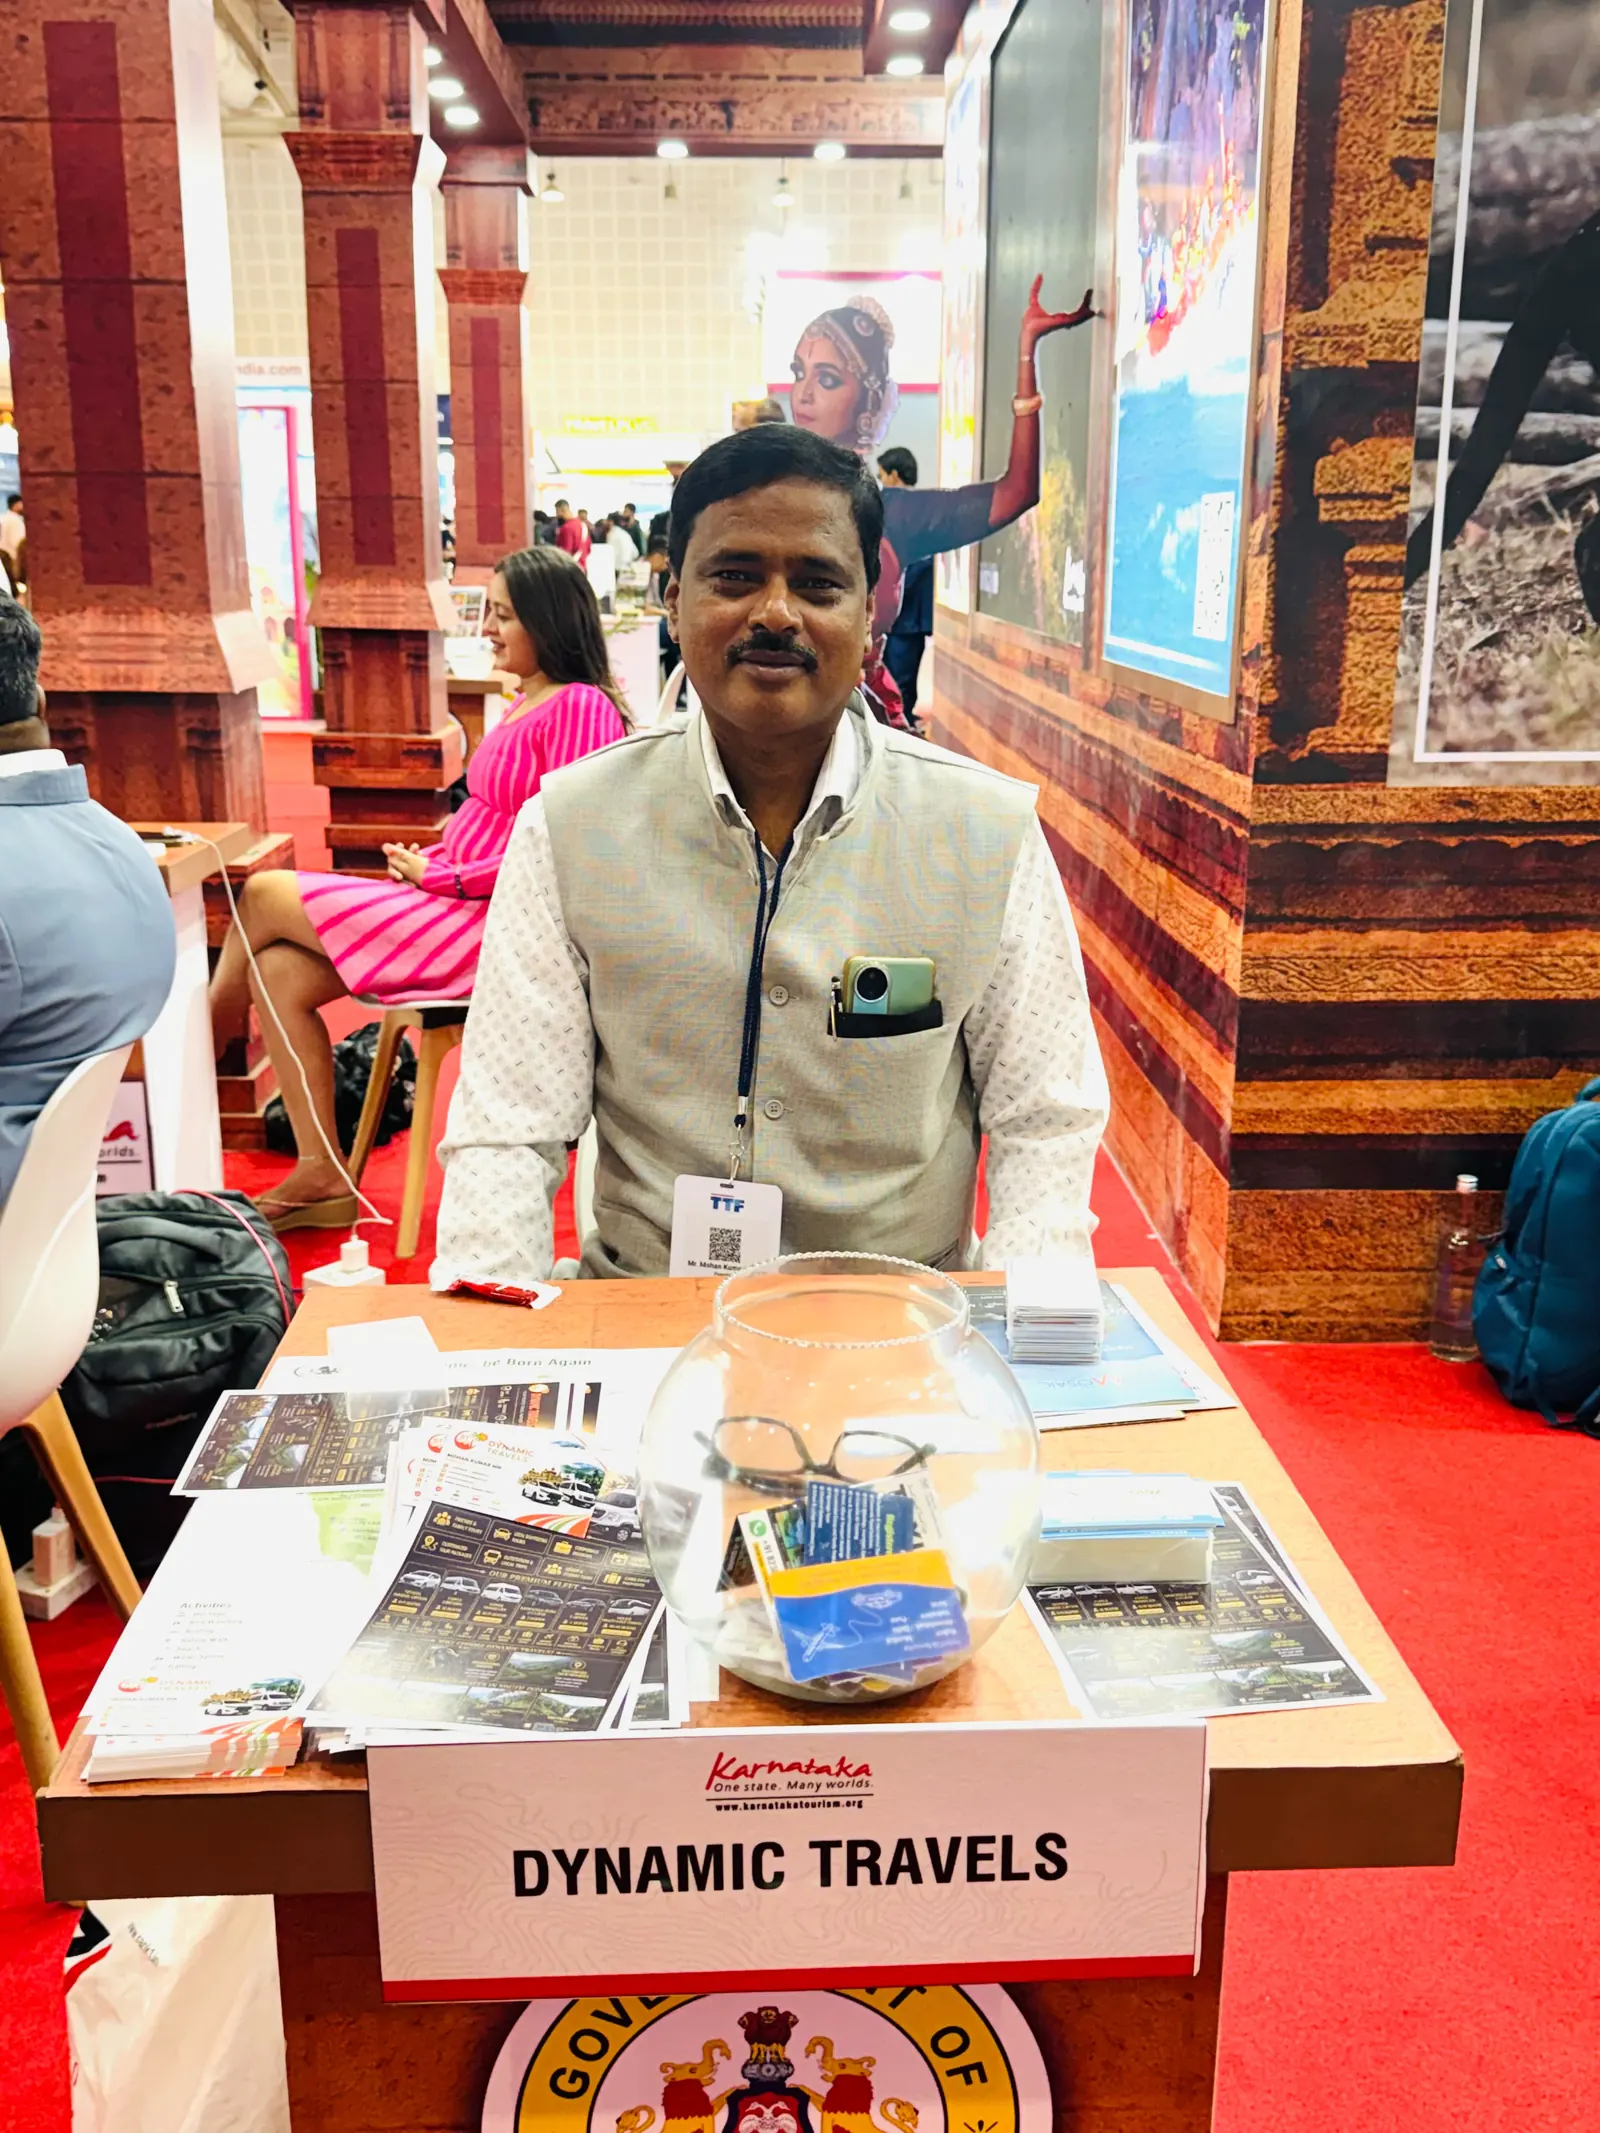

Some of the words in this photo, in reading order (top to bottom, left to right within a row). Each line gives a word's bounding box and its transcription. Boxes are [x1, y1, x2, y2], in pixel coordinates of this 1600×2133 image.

[710, 1196, 745, 1212] TTF
[506, 1358, 542, 1366] Born
[547, 1358, 592, 1367] Again
[487, 1448, 529, 1463] TRAVELS
[488, 1440, 534, 1458] DYNAMIC
[488, 1570, 508, 1579] OUR
[509, 1574, 551, 1586] PREMIUM
[705, 1752, 873, 1790] Karnataka
[714, 1782, 740, 1793] One
[744, 1780, 782, 1792] state.
[787, 1780, 822, 1793] Many
[826, 1778, 874, 1789] worlds.
[715, 1800, 863, 1812] www.karnatakatourism.org
[512, 1841, 786, 1898] DYNAMIC
[808, 1832, 1069, 1889] TRAVELS
[930, 2025, 988, 2086] OF
